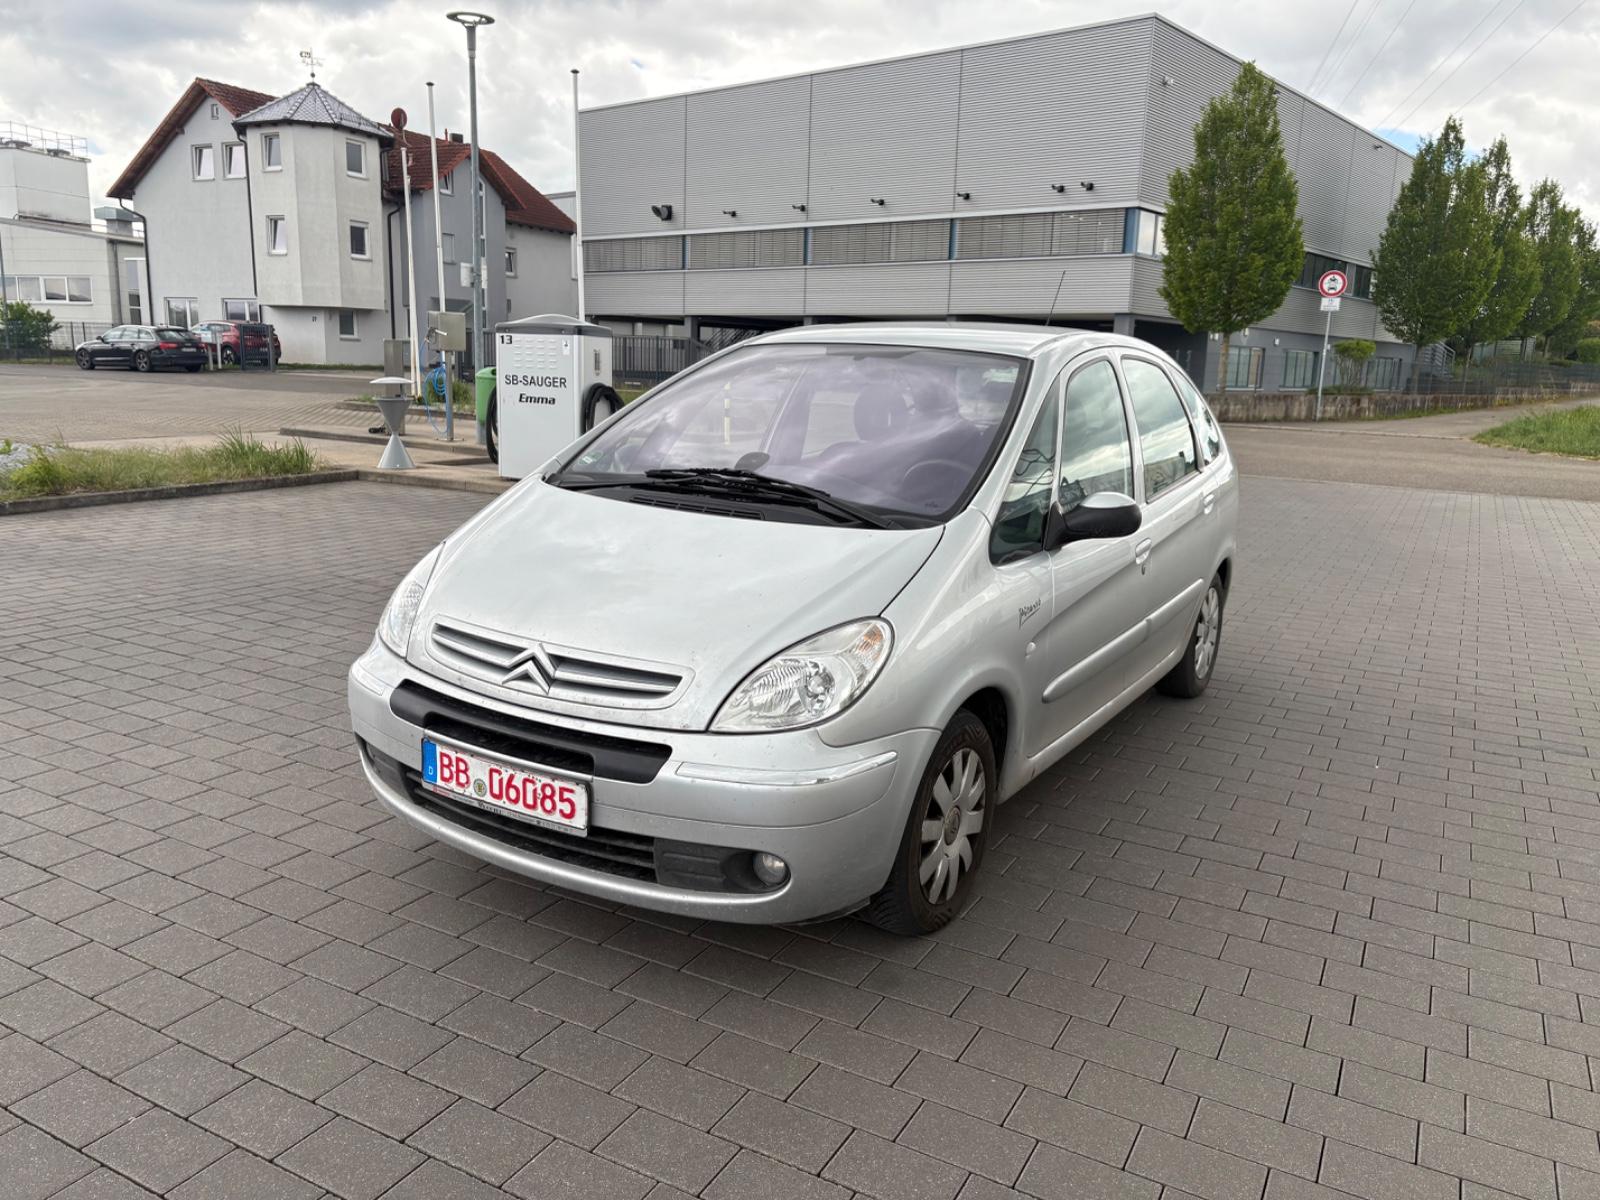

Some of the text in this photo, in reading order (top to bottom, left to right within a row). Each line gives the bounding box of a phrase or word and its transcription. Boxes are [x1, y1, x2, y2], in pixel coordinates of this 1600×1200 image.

[500, 335, 513, 345] 13
[504, 374, 567, 388] SB-SAUGER
[518, 393, 556, 405] Emma
[428, 765, 434, 775] D
[439, 751, 471, 788] BB
[489, 767, 576, 820] 06085
